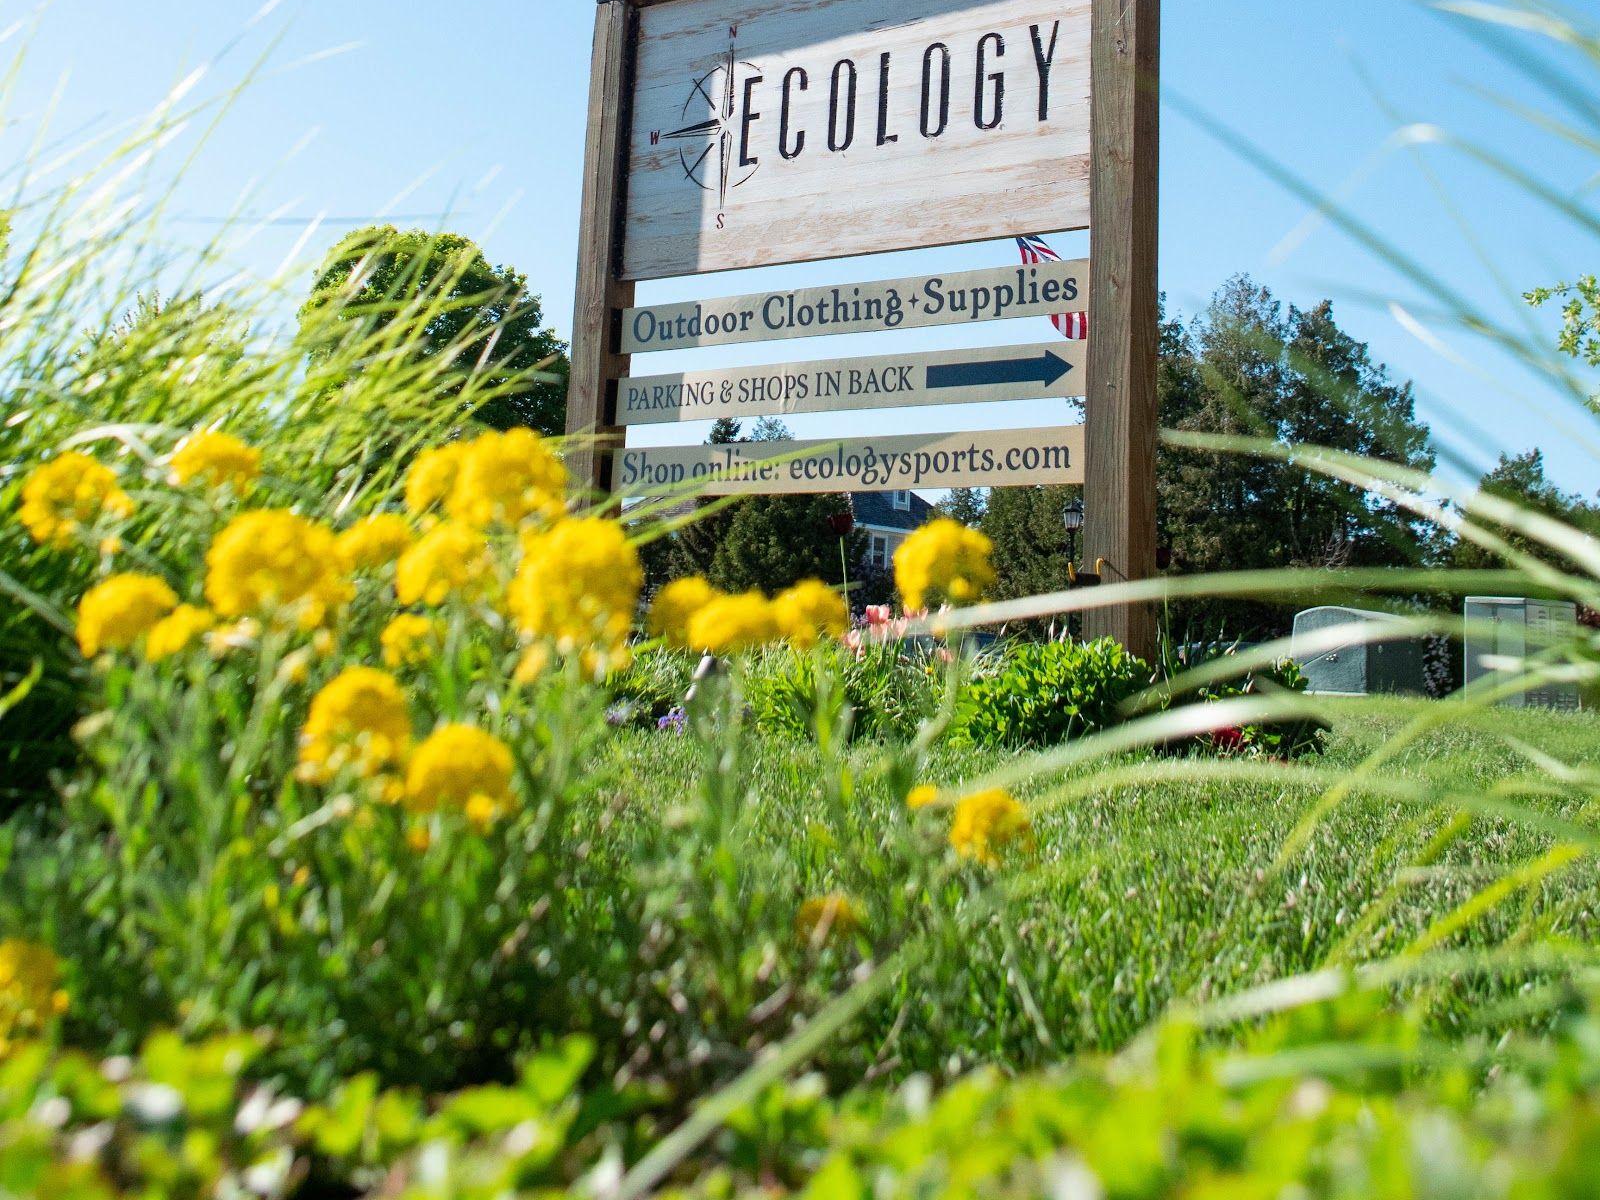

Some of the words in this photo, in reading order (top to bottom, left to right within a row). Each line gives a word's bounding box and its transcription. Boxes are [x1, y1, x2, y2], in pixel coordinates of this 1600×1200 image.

[729, 24, 738, 39] N
[739, 20, 1060, 167] ECOLOGY
[650, 129, 660, 145] W
[716, 213, 725, 229] S
[633, 304, 753, 343] Outdoor
[627, 380, 714, 411] PARKING
[719, 379, 734, 404] &
[738, 373, 809, 403] SHOPS
[815, 370, 841, 397] IN
[848, 365, 914, 395] BACK
[622, 451, 685, 491] Shop
[790, 442, 1071, 485] ecologysports.com
